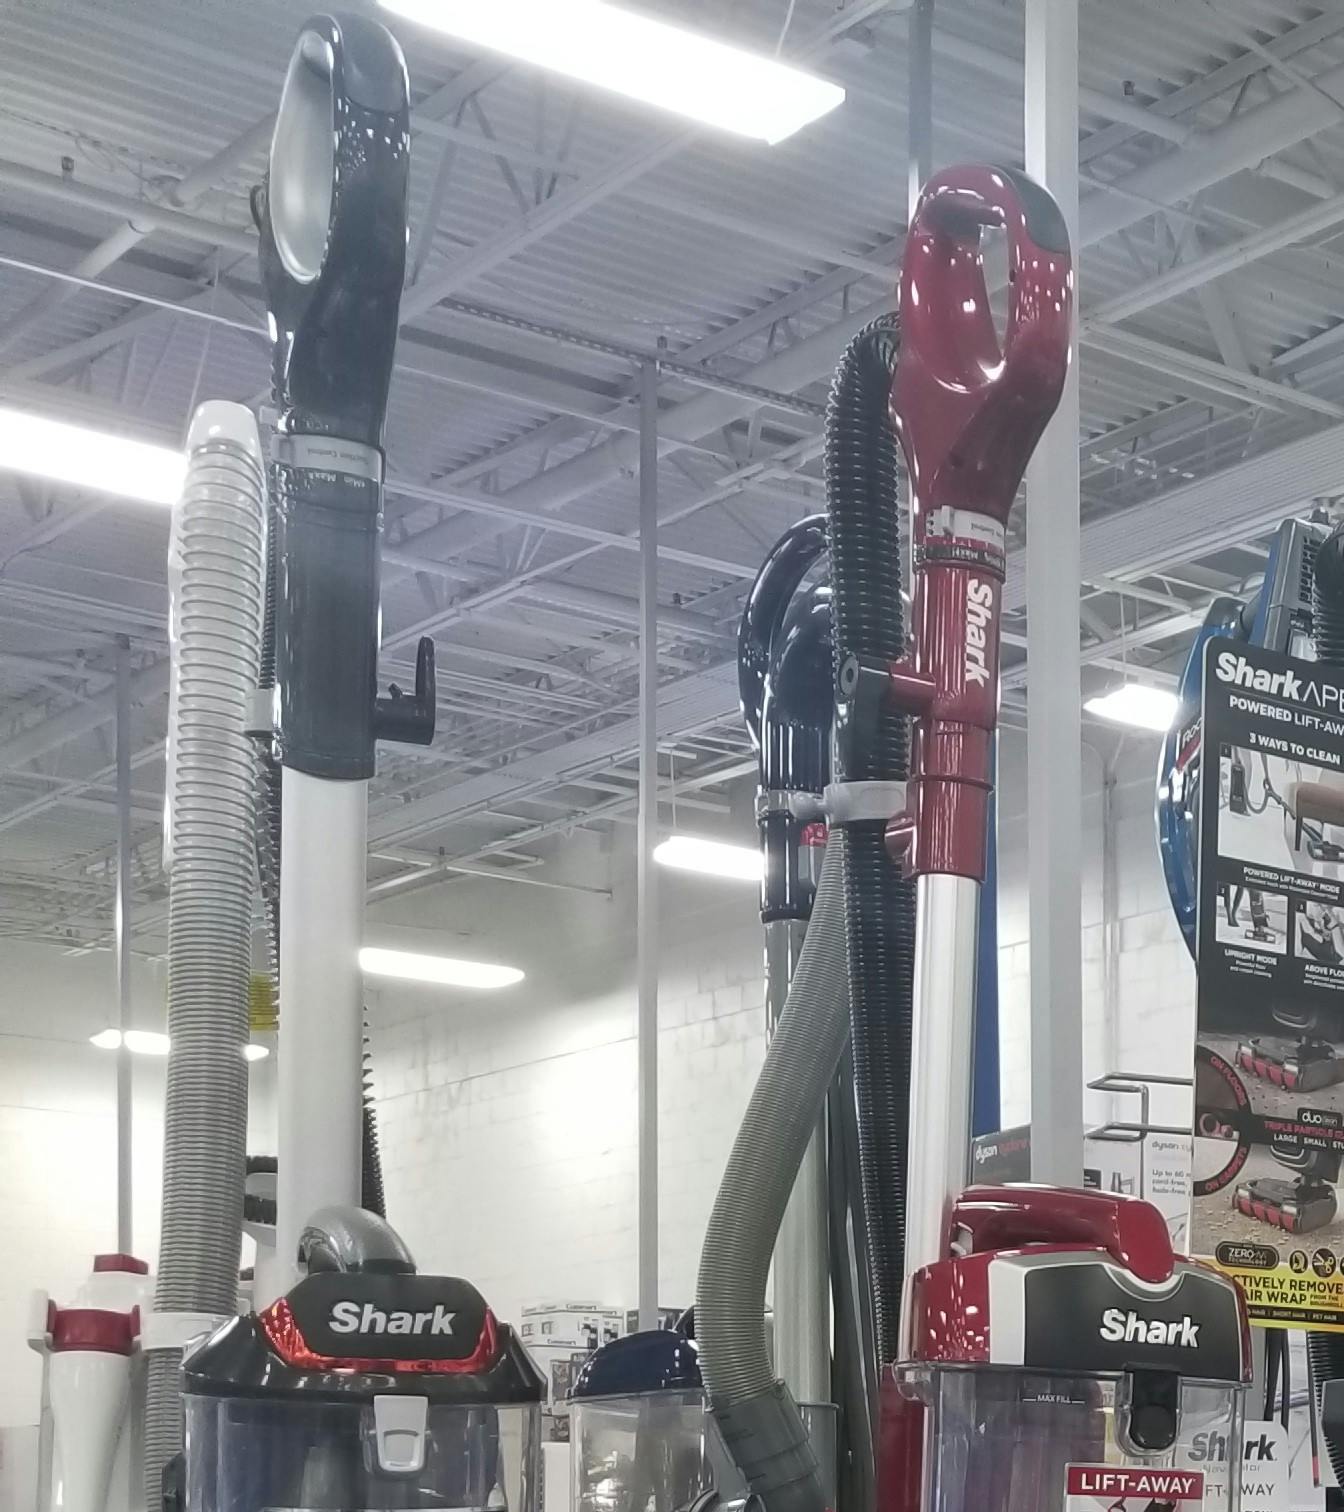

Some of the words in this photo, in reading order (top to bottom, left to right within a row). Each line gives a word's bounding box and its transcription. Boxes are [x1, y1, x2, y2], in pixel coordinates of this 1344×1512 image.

[965, 579, 993, 688] Shark
[1216, 652, 1303, 700] Shark
[1229, 695, 1292, 722] POWERED
[1250, 732, 1256, 744] 3
[1257, 735, 1288, 751] WAYS
[1290, 743, 1304, 755] TO
[1306, 746, 1341, 765] CLEAN
[1243, 866, 1280, 881] POWERED
[1320, 883, 1341, 894] MODE
[975, 1145, 998, 1163] dyson
[1273, 1133, 1298, 1144] LARGE
[1303, 1138, 1327, 1148] SMALL
[328, 1301, 457, 1335] Shark
[1100, 1308, 1200, 1349] Shark
[1080, 1473, 1193, 1495] LIFT-AWAY
